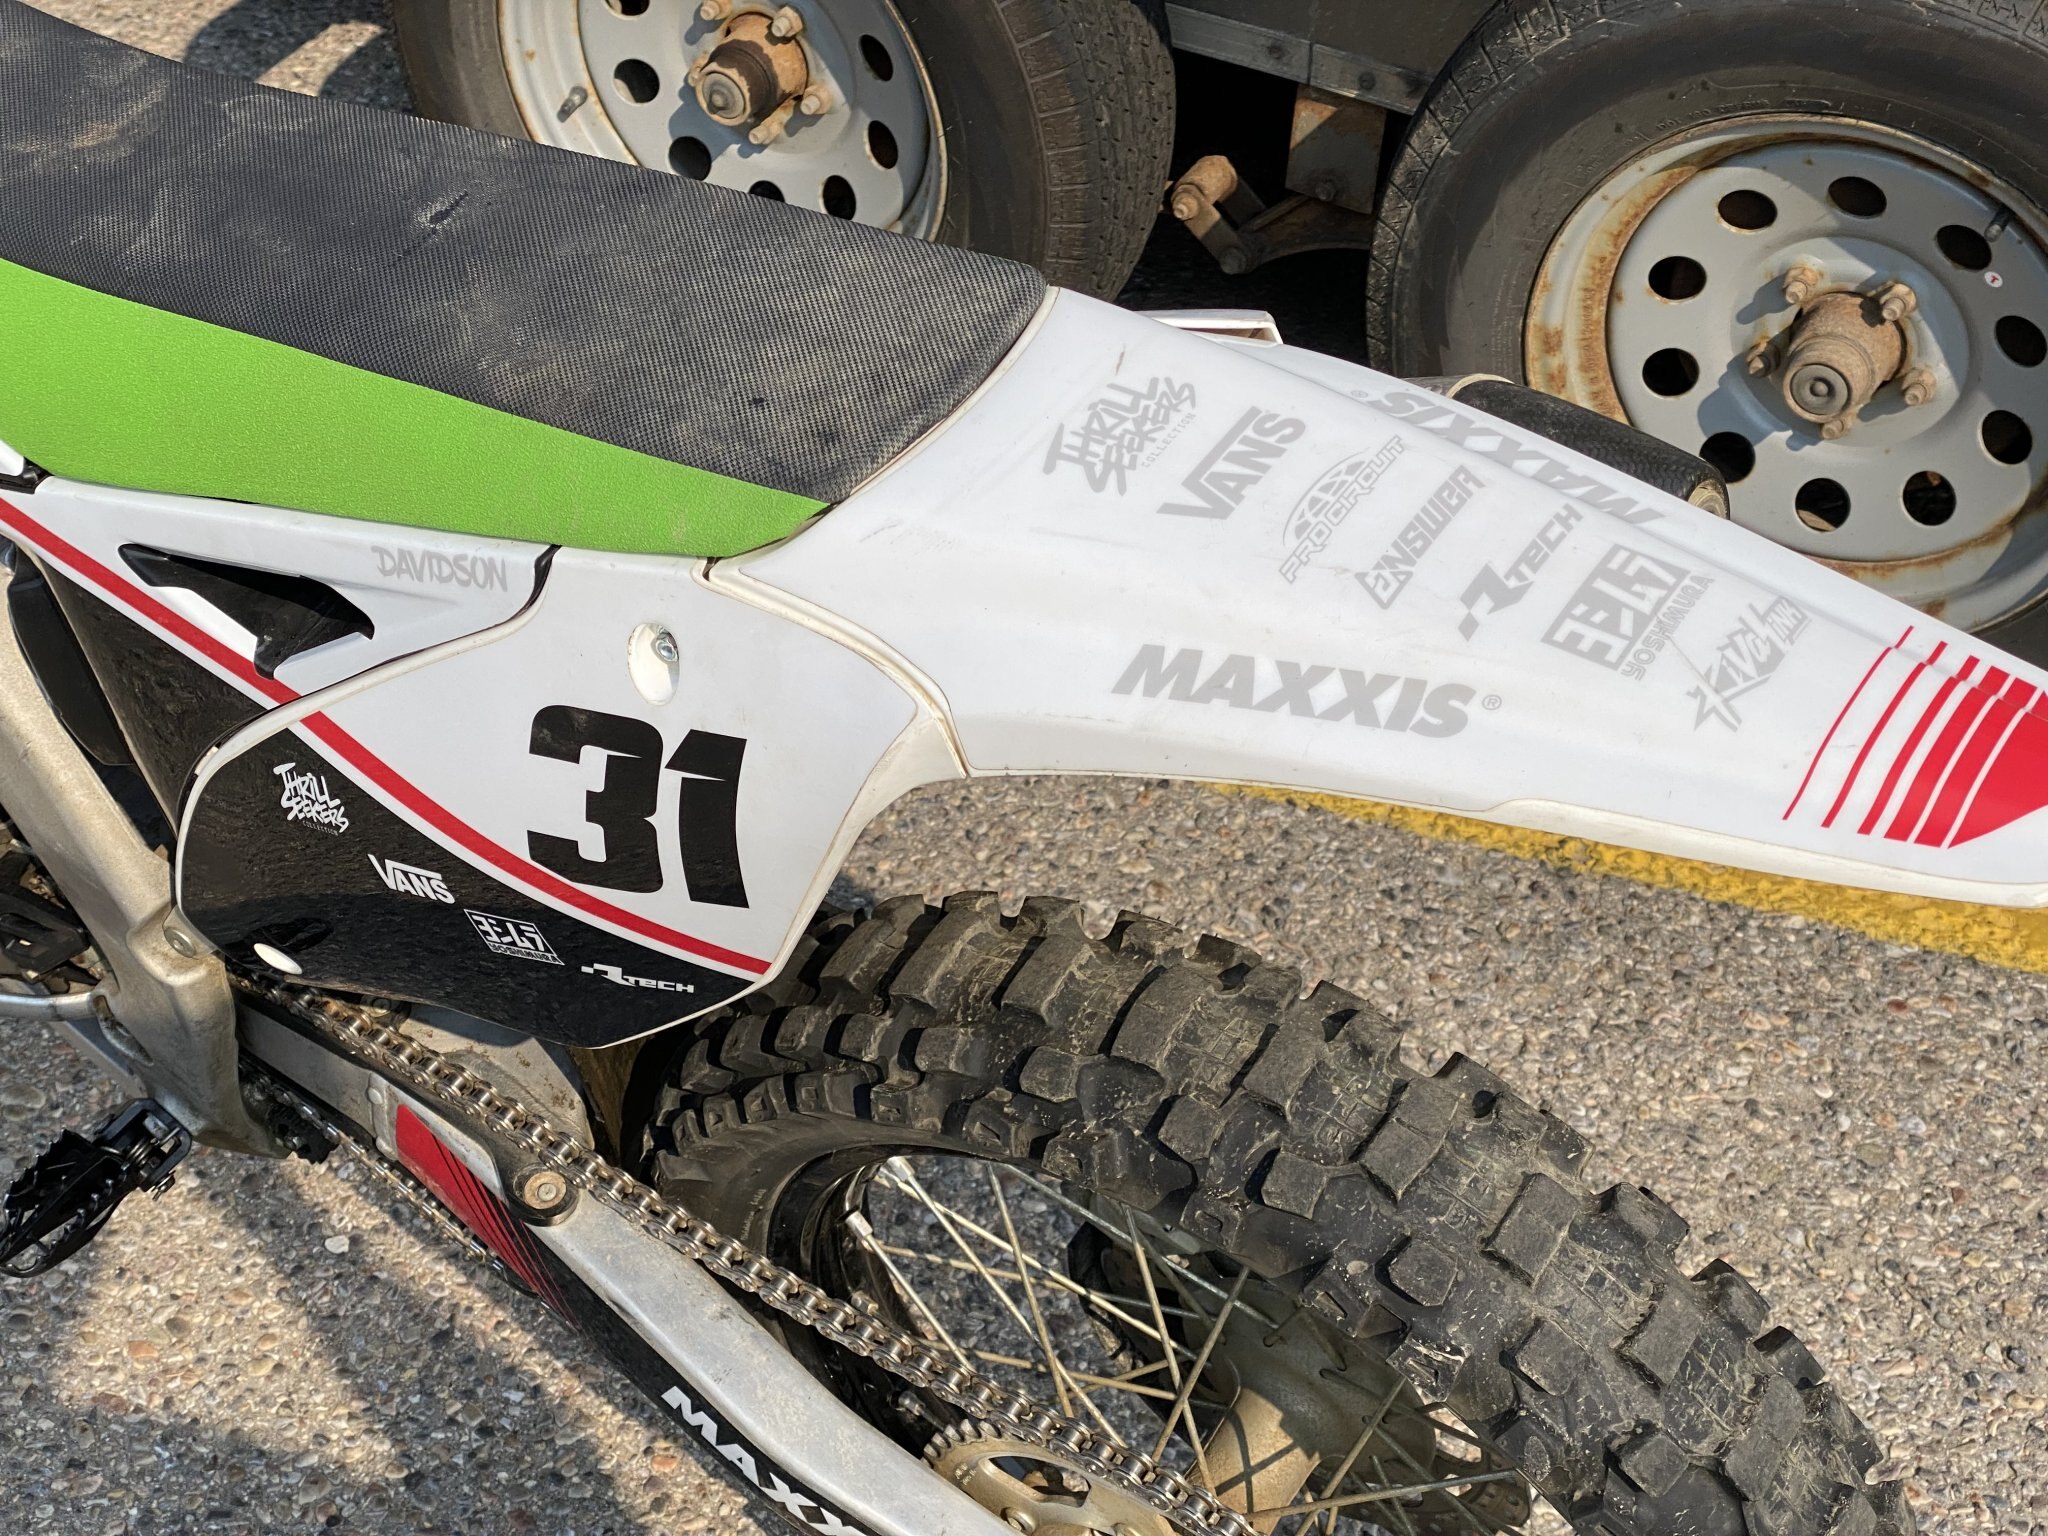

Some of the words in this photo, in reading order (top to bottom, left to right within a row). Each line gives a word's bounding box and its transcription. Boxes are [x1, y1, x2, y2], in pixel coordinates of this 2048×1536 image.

[1043, 376, 1160, 476] THRILL
[1083, 376, 1197, 497] SEEKERS
[1140, 411, 1197, 469] COLLECTION
[1156, 405, 1307, 521] VANS
[1365, 391, 1666, 525] MAXXIS
[1278, 518, 1333, 585] PRO
[1331, 434, 1406, 528] CIRCUIT
[1353, 464, 1487, 611] ANSWER
[371, 545, 508, 593] DAVIDSON
[1619, 573, 1716, 682] YOSHIMURA
[1111, 643, 1478, 738] MAXXIS
[272, 762, 341, 809] THRILL
[280, 790, 349, 834] SEEKERS
[526, 704, 750, 909] 31
[367, 853, 456, 904] VANS
[487, 942, 562, 965] YOSHIMURA
